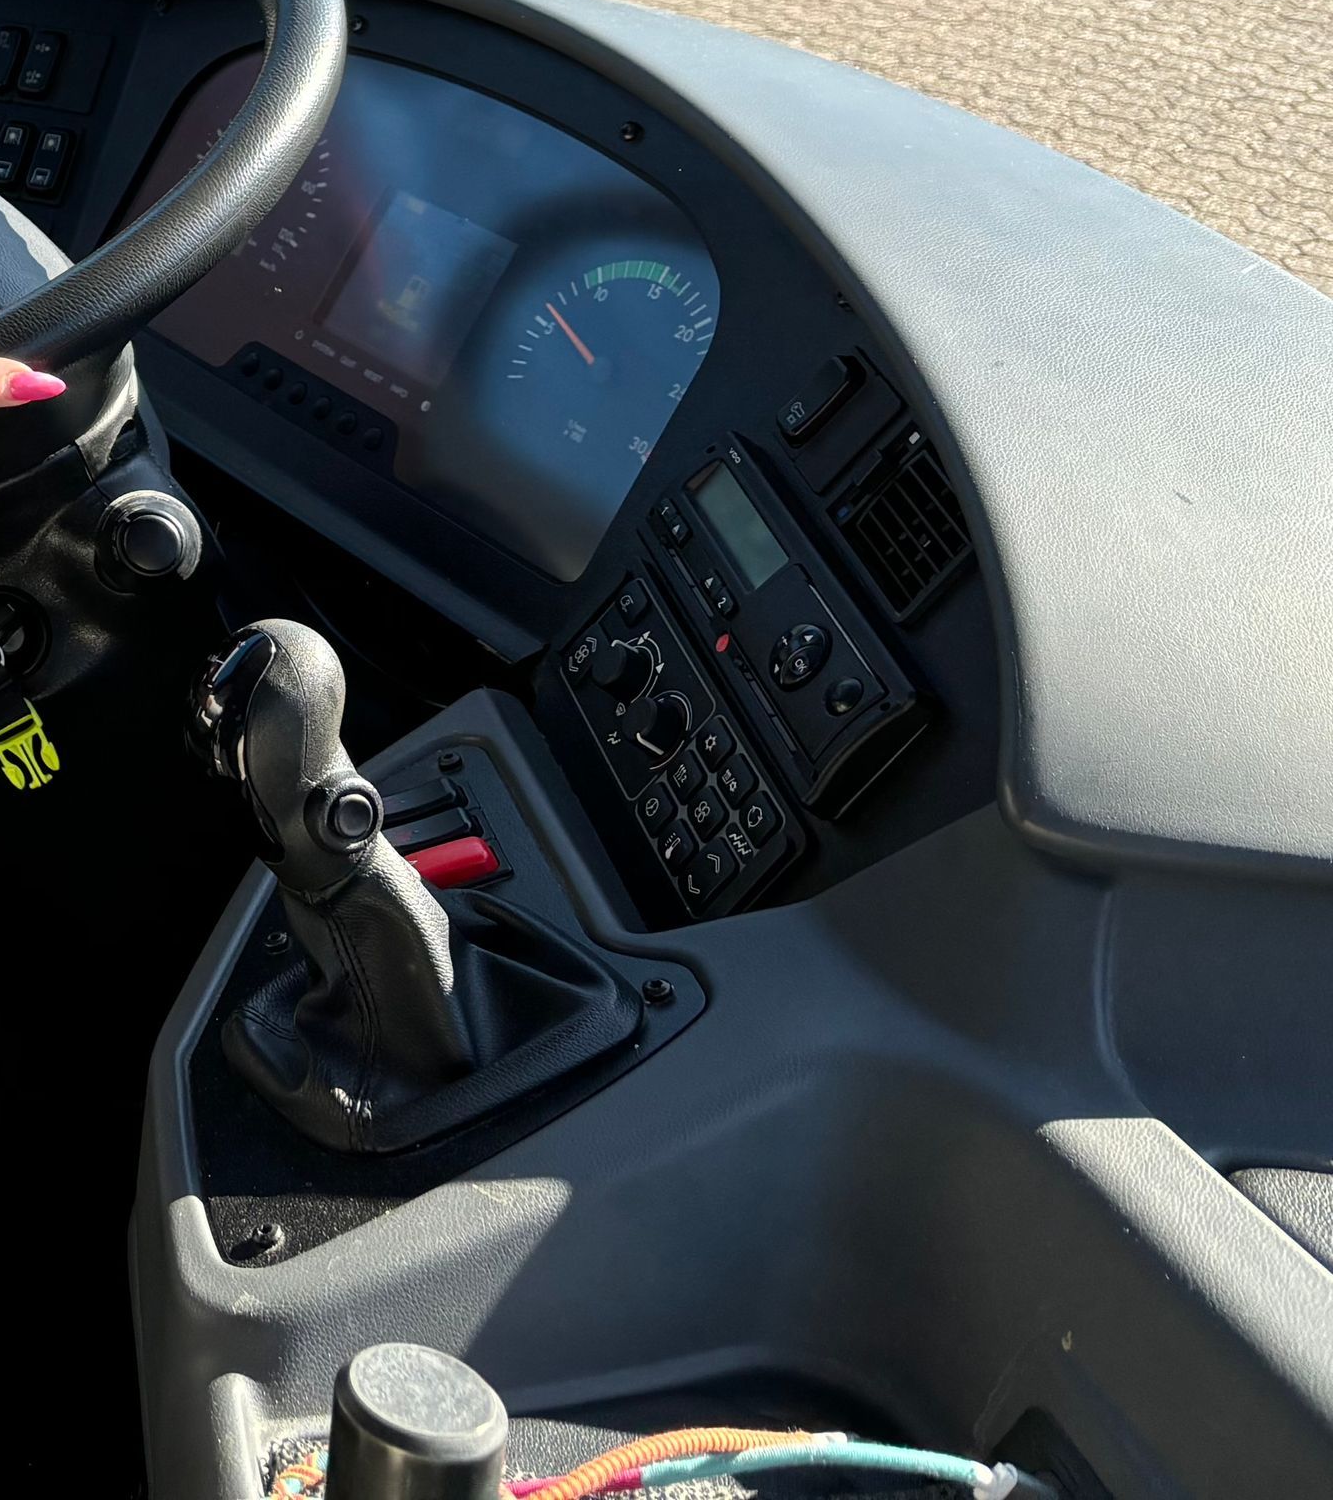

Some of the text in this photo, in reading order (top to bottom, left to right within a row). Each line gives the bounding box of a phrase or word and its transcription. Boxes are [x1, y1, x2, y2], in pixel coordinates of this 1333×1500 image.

[593, 286, 609, 302] 10
[647, 283, 663, 299] 15
[544, 321, 555, 335] 5
[673, 325, 695, 342] 20
[629, 436, 649, 454] 30
[718, 597, 726, 608] 2
[794, 658, 808, 673] OK
